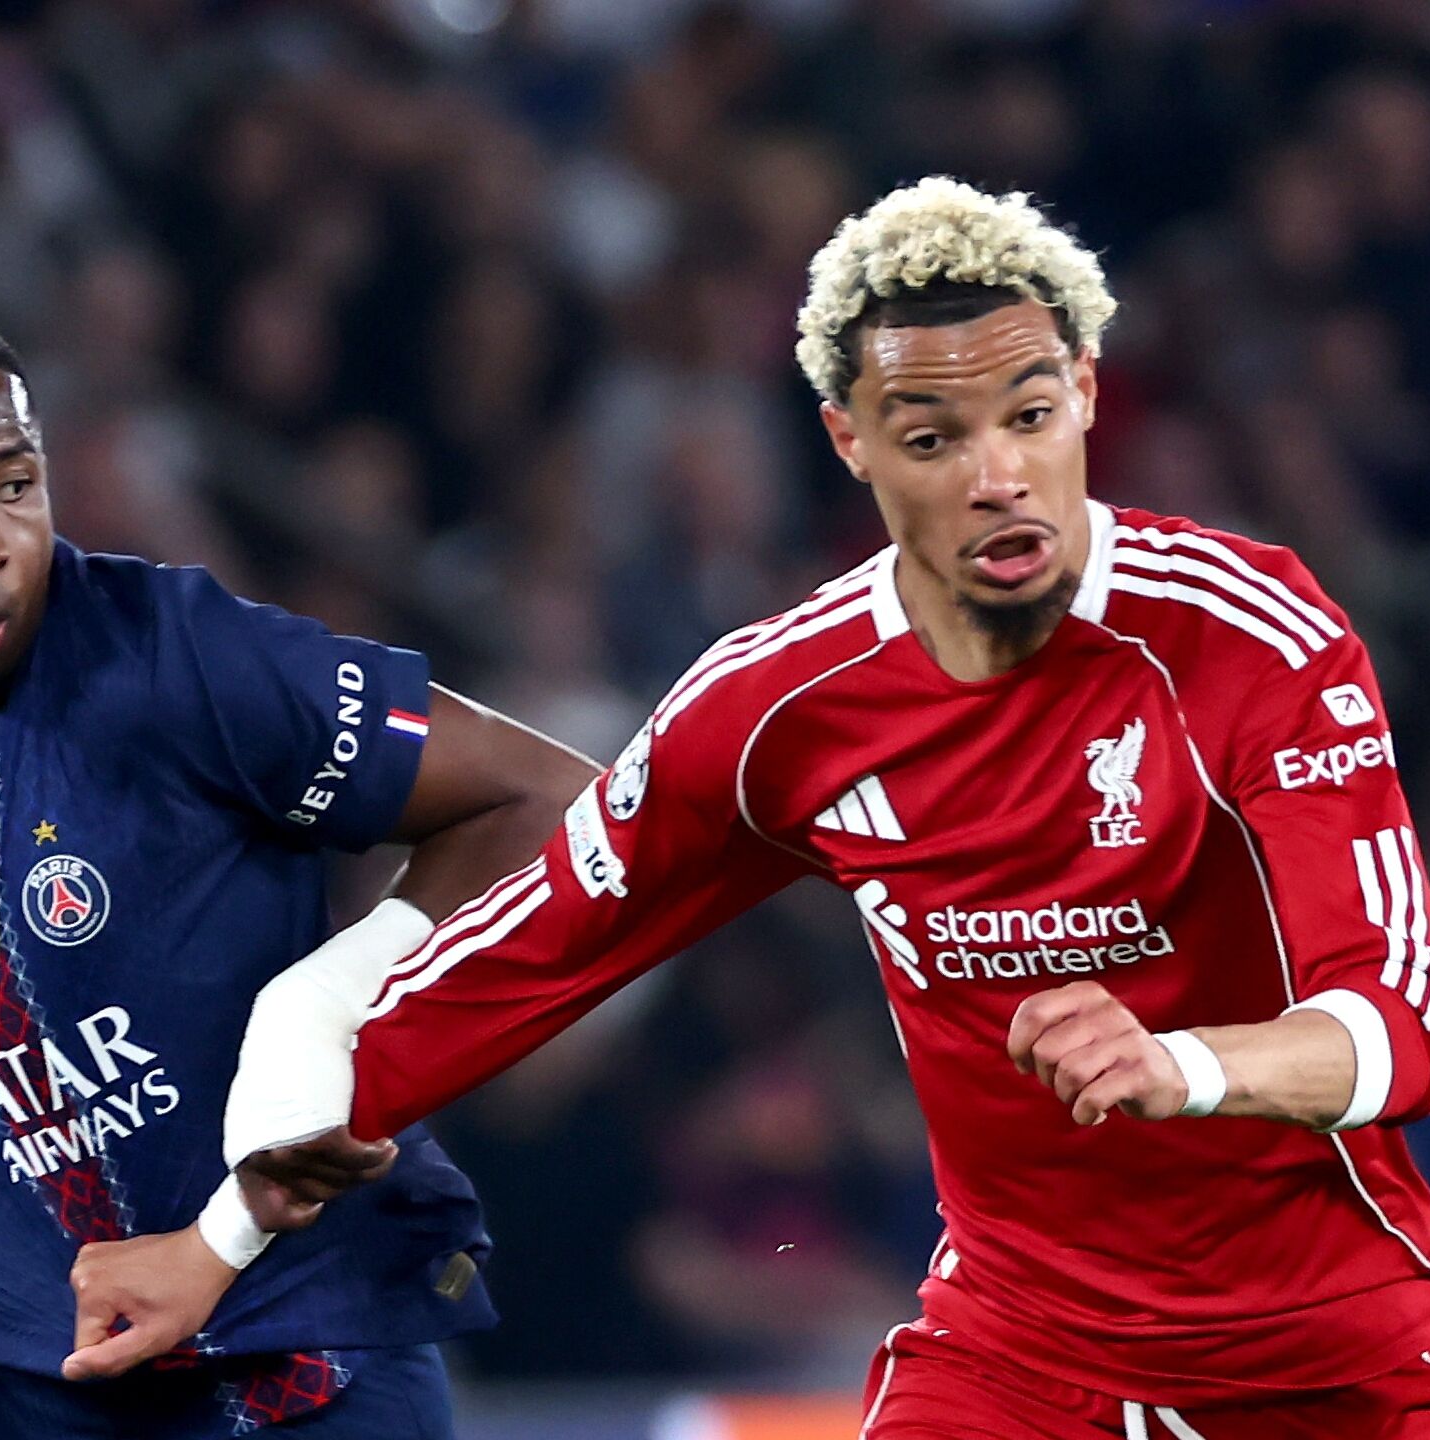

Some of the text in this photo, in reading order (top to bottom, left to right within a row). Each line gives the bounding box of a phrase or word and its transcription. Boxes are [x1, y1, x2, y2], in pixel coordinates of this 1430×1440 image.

[286, 661, 365, 826] BEYOND
[29, 859, 84, 890] PARIS
[924, 897, 1148, 944] standard
[934, 924, 1176, 980] chartered
